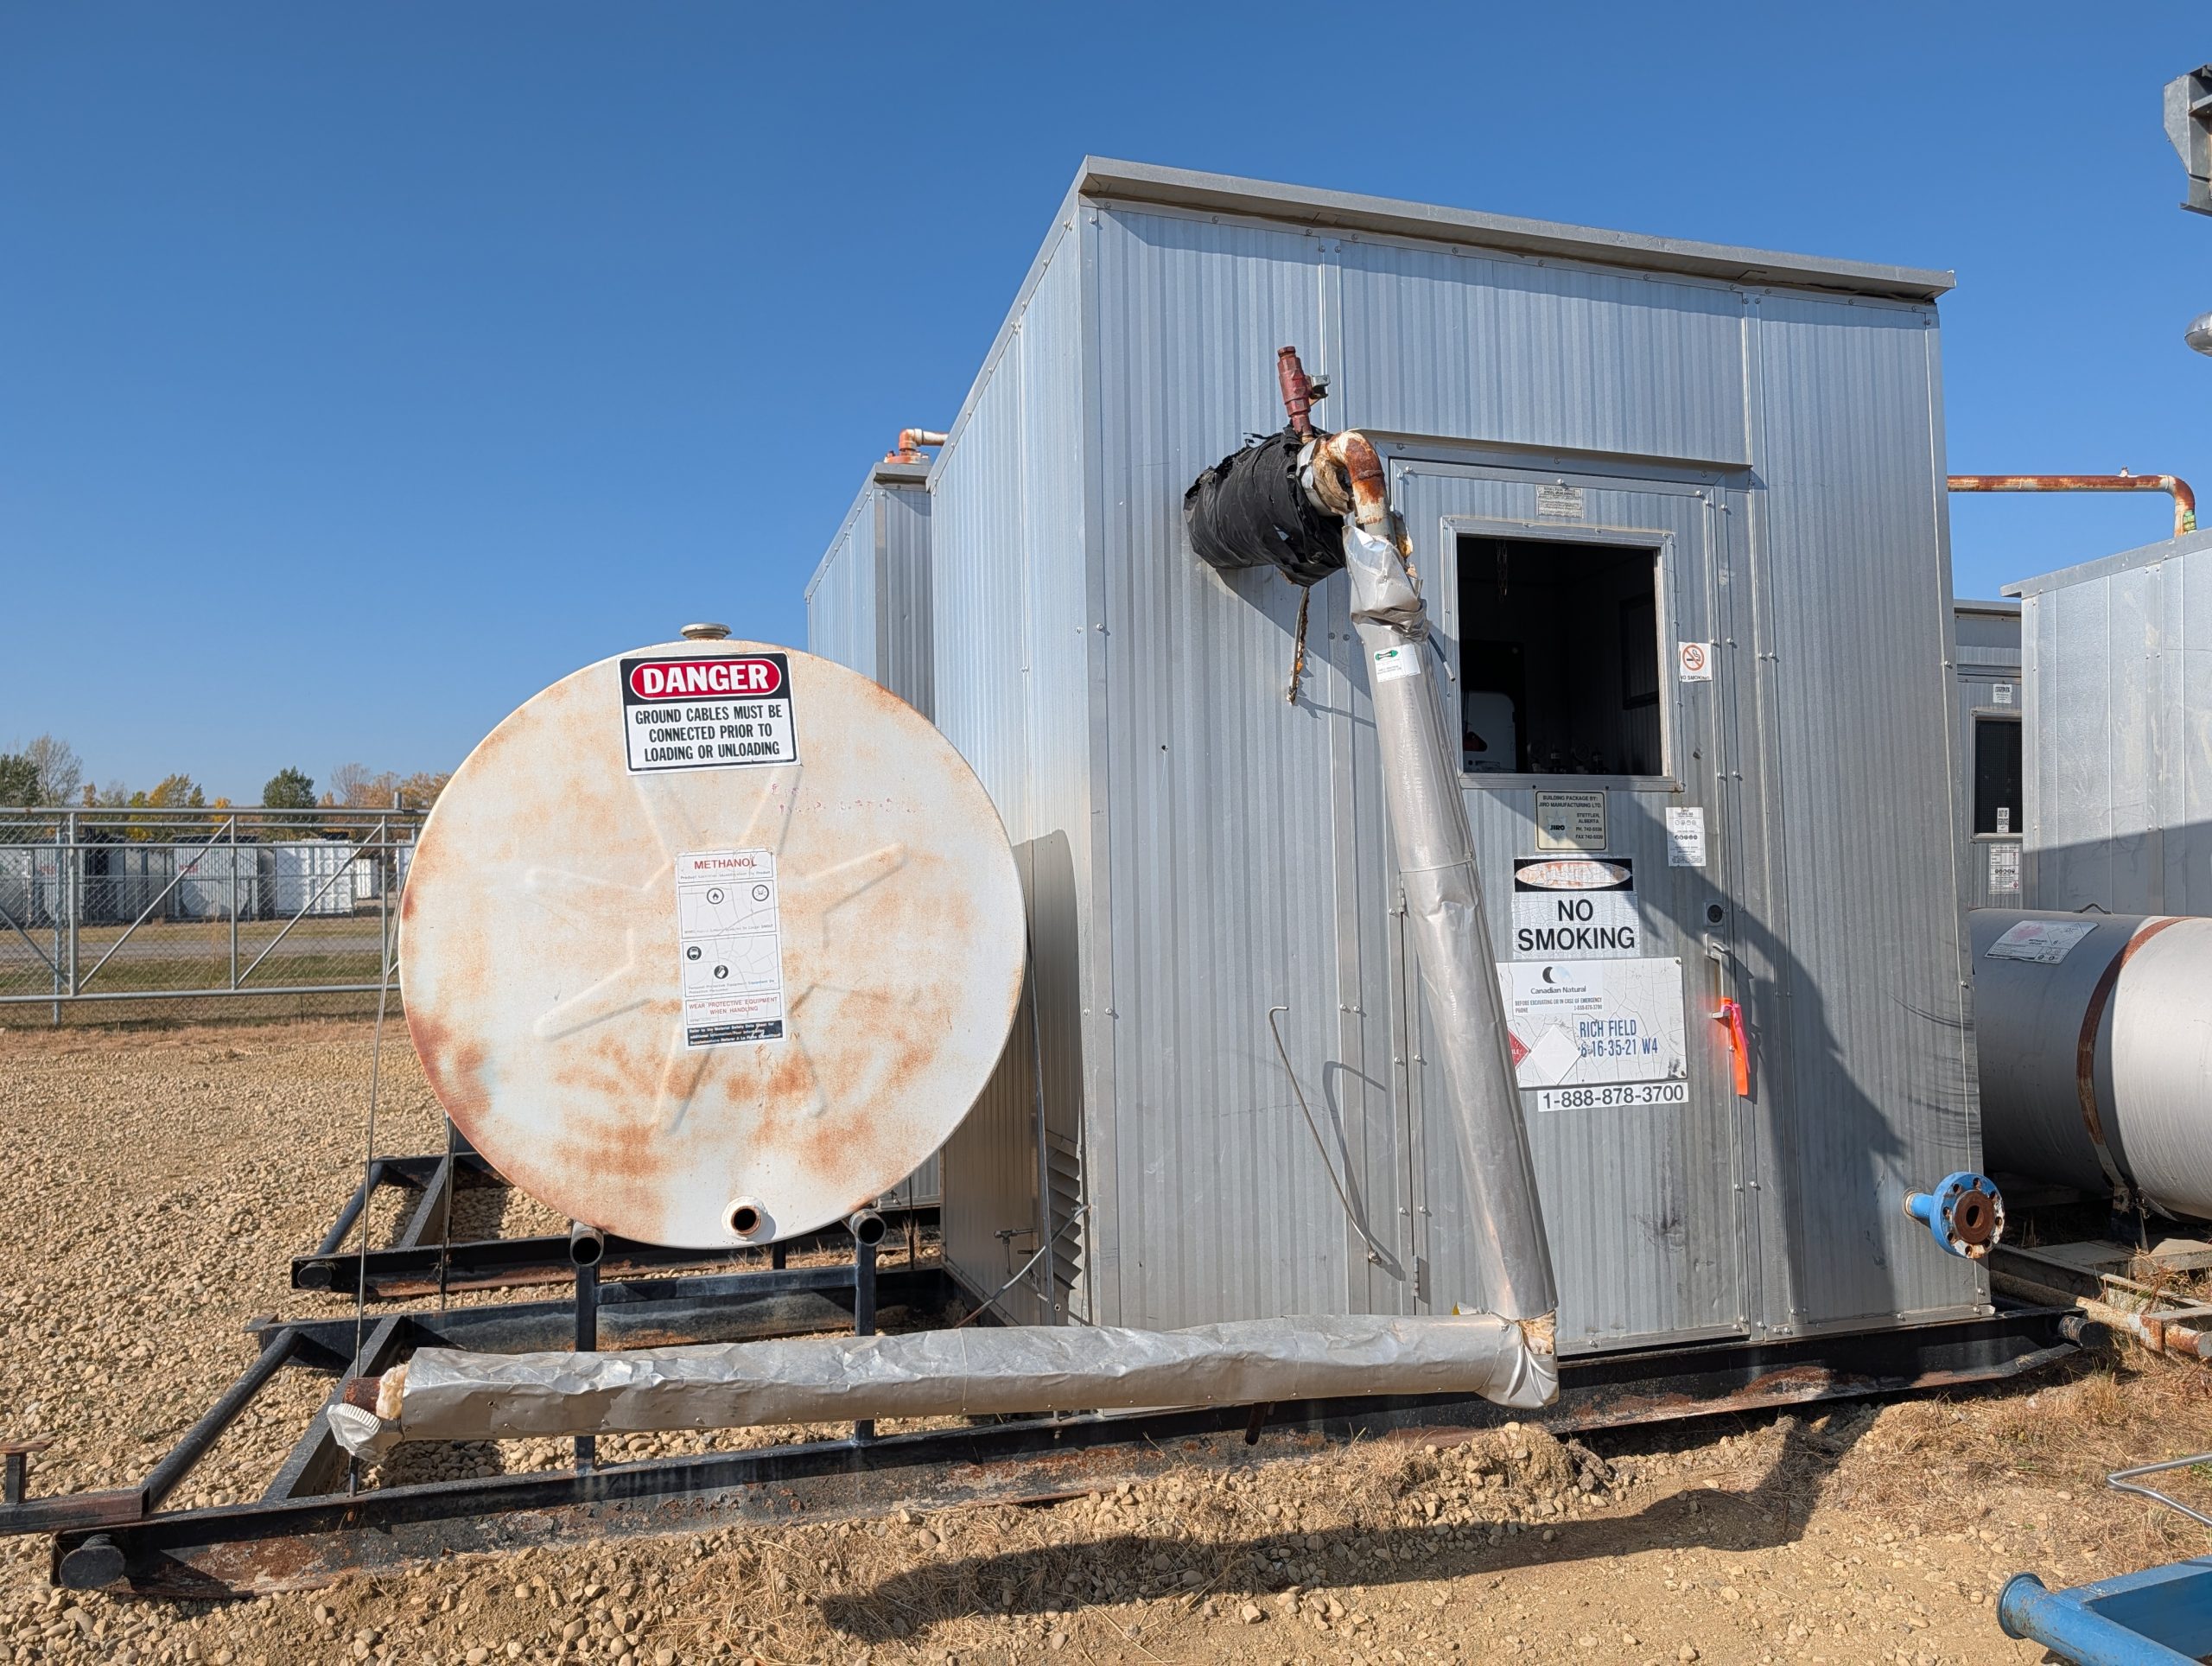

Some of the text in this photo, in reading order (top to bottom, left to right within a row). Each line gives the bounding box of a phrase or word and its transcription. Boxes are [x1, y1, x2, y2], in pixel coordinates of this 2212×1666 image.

[643, 664, 769, 694] DANGER
[636, 704, 782, 725] GROUND CABLES MUST BE
[649, 723, 772, 743] CONNECTED PRIOR TO
[644, 742, 780, 762] LOADING OR UNLOADING
[694, 858, 757, 869] METHANOL
[1557, 899, 1593, 922] NO
[1517, 927, 1635, 951] SMOKING
[1580, 1020, 1636, 1037] RICH FIELD
[1642, 1037, 1658, 1054] W4
[1543, 1085, 1684, 1109] 1-888-878-3700
